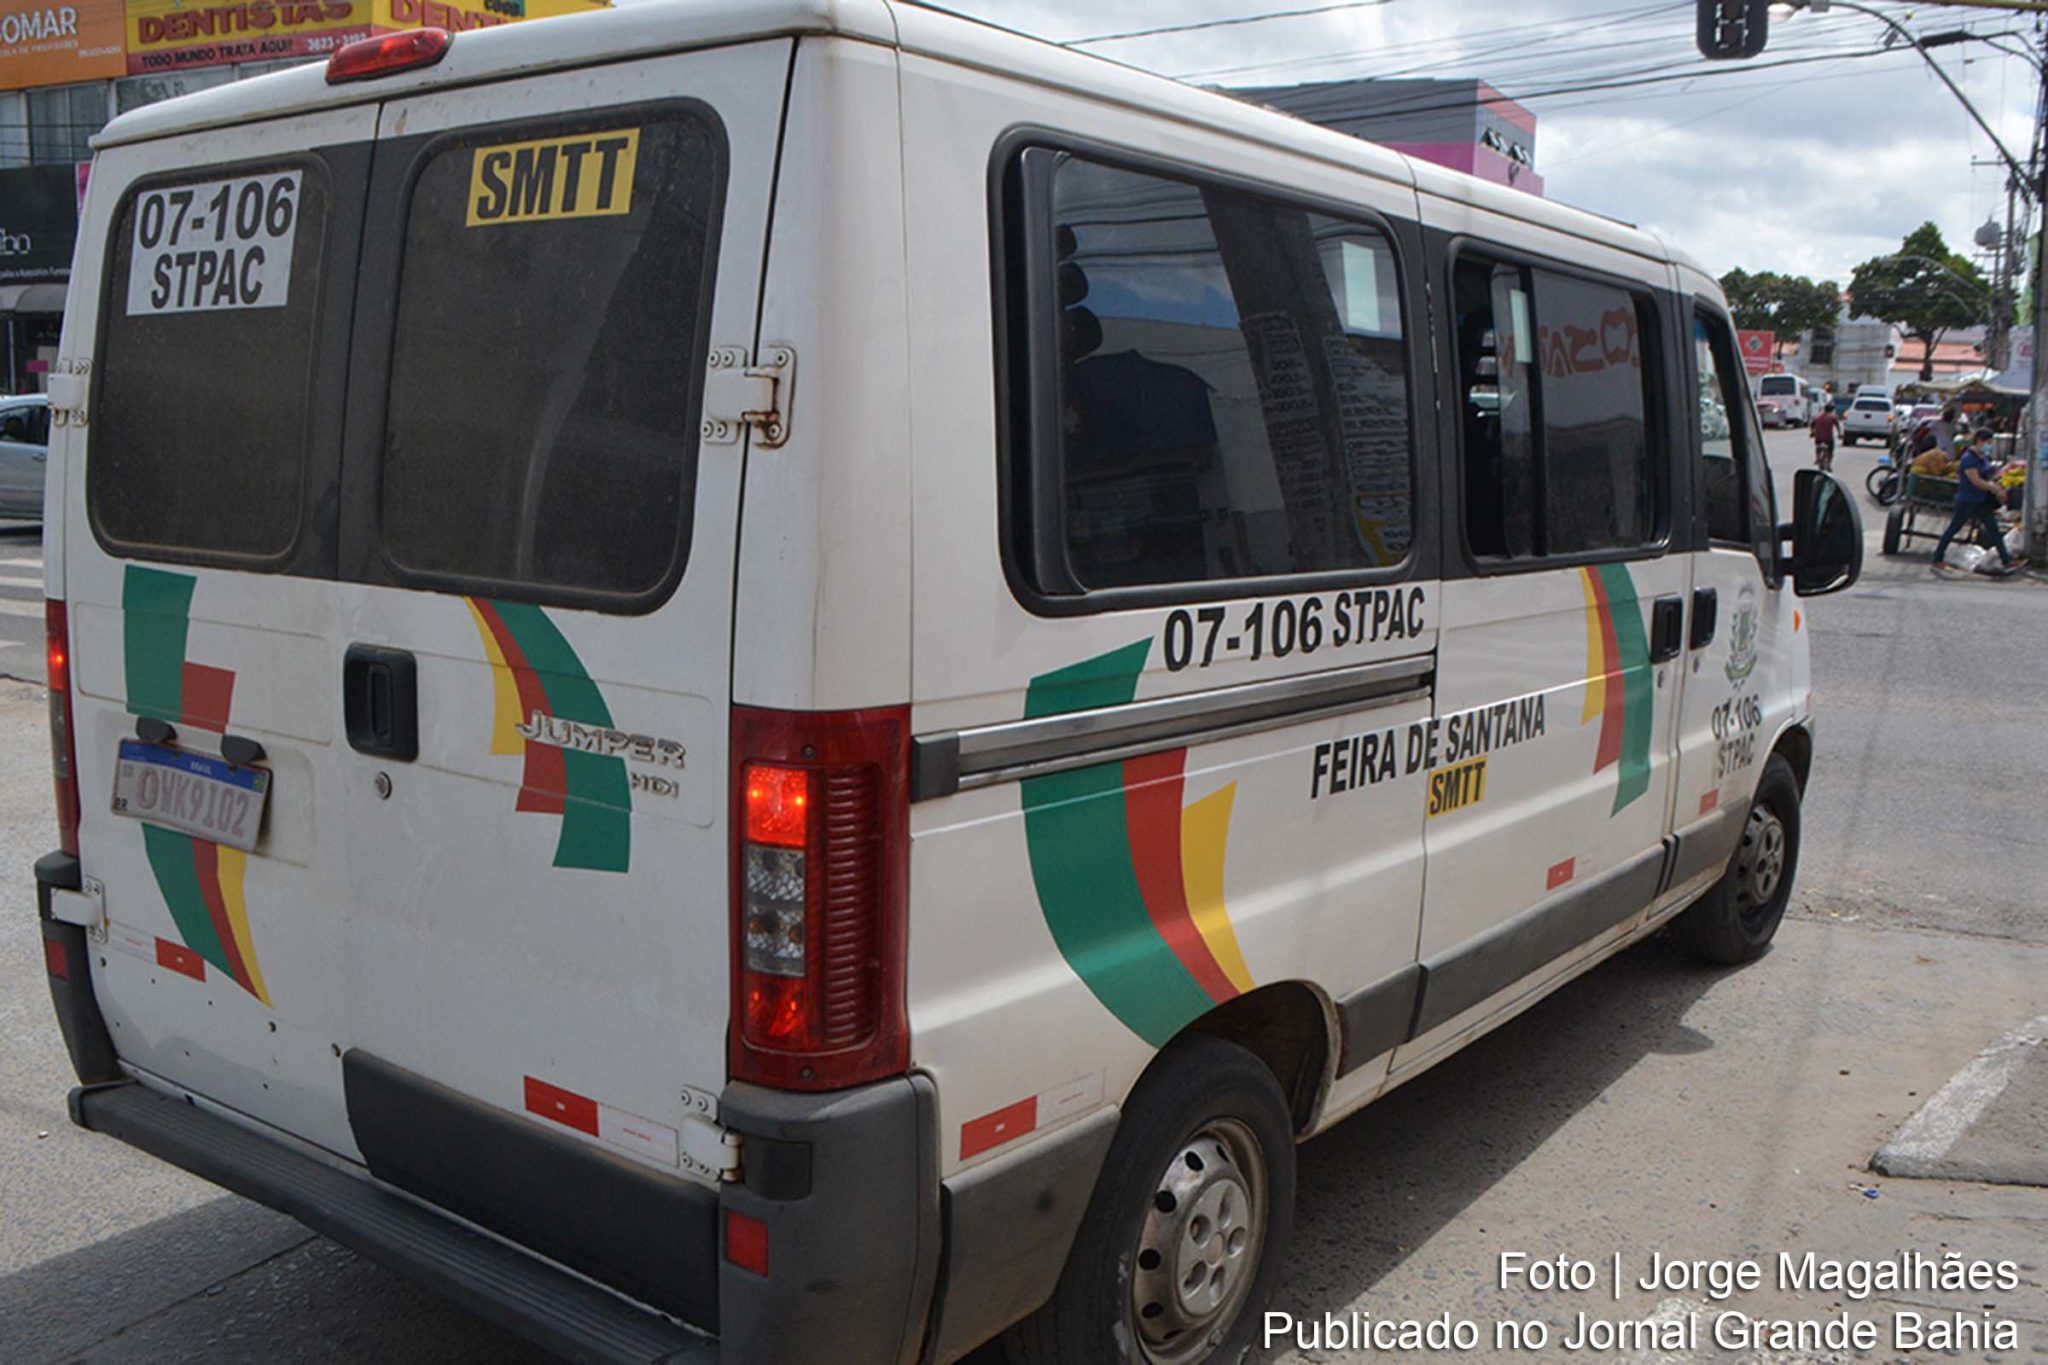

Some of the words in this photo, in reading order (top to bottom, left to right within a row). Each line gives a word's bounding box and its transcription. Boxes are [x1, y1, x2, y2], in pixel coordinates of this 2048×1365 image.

[0, 6, 77, 45] OMAR
[138, 0, 353, 44] DENTISTAS
[141, 51, 171, 68] TODO
[175, 46, 216, 64] MUNDO
[219, 42, 256, 59] TRATA
[476, 136, 629, 220] SMTT
[138, 176, 296, 250] 07-106
[150, 245, 266, 310] STPAC
[1163, 595, 1324, 673] 07-106
[1332, 585, 1425, 648] STPAC
[514, 708, 687, 770] JUMPER
[1310, 729, 1397, 799] FEIRA
[1405, 719, 1441, 776] DE
[1445, 693, 1546, 764] SANTANA
[1711, 692, 1763, 742] 07-106
[1717, 731, 1756, 779] STPAC
[1429, 760, 1487, 816] SMTT
